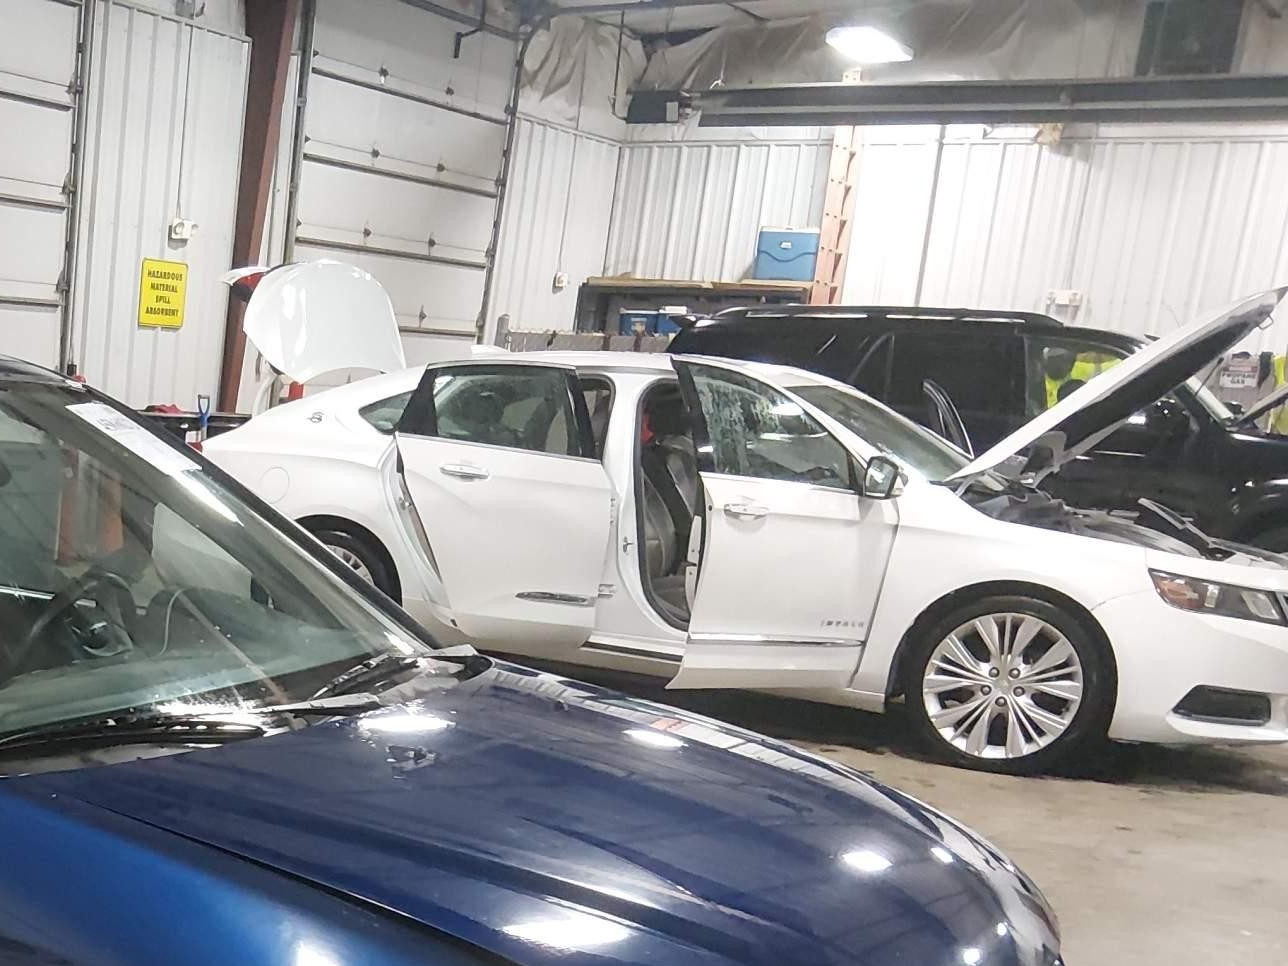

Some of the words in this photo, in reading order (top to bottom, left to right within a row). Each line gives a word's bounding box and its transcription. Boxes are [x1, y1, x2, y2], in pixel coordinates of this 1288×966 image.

[147, 270, 183, 280] HAZARDOUS
[151, 282, 177, 293] MATERIAL
[156, 295, 170, 304] SPILL
[146, 306, 179, 317] ABSORBENT
